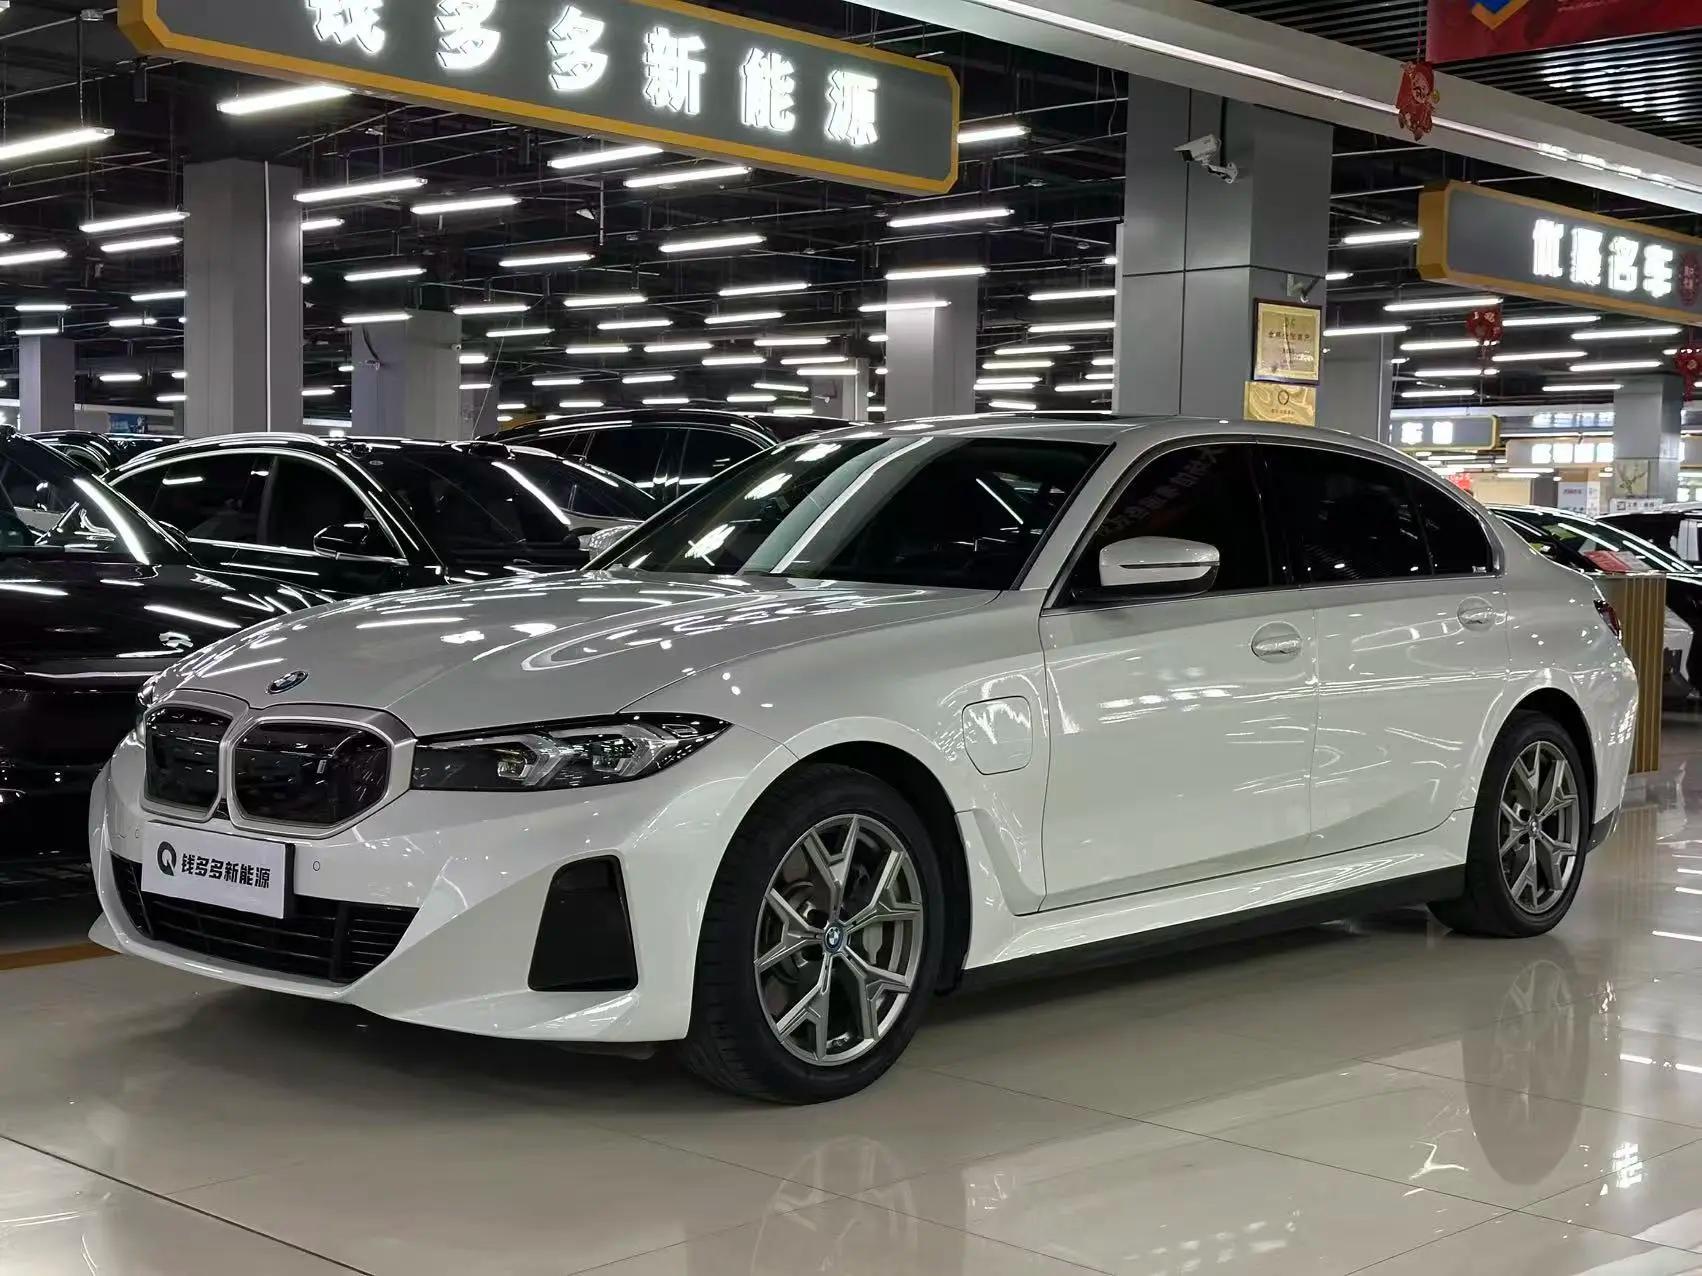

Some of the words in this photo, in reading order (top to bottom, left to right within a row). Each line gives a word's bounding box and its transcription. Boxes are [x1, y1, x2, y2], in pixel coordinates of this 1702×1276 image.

[181, 853, 271, 889] 钱多多新能源
